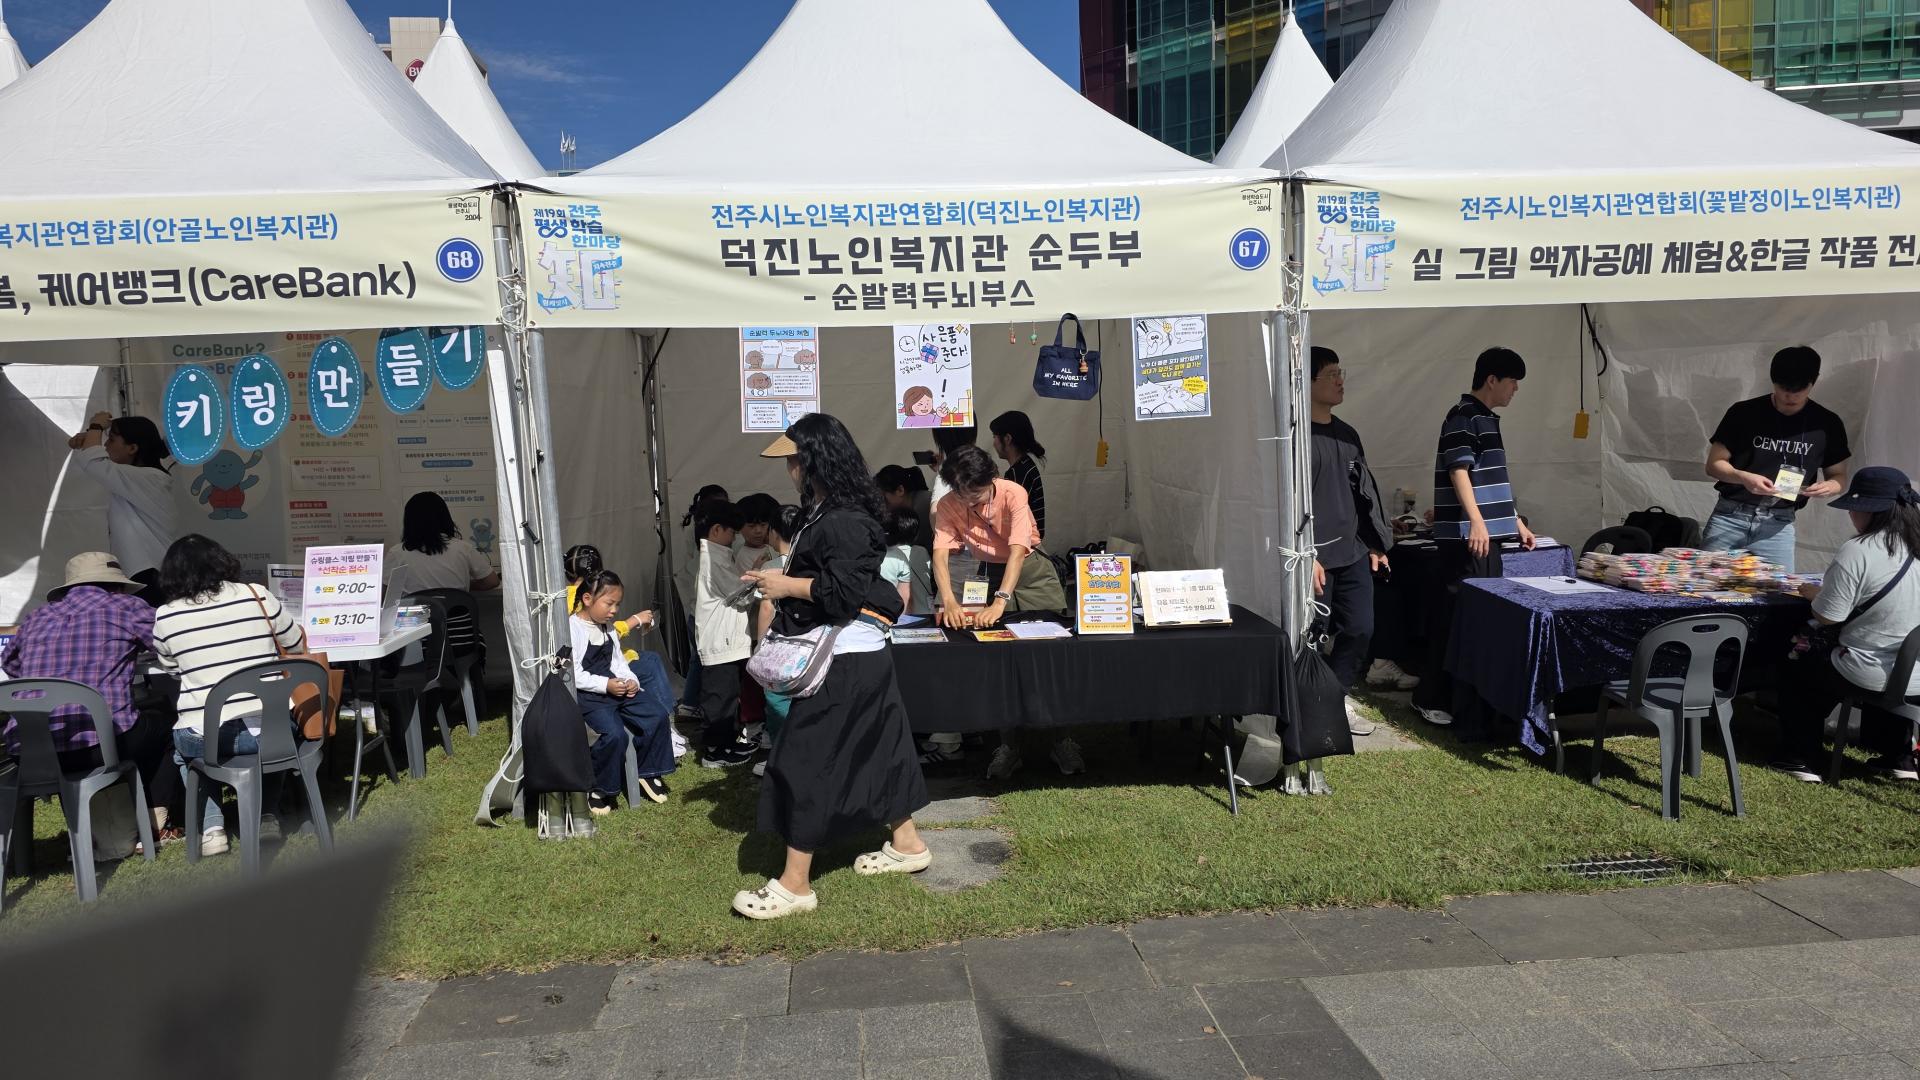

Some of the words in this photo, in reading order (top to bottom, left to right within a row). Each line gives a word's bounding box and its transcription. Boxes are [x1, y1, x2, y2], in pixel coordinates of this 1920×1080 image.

[1317, 195, 1347, 204] 제19회
[1350, 192, 1381, 205] 전주
[1460, 184, 1901, 221] 전주시노인복지관연합회(꽃밭정이노인복지관)
[533, 208, 566, 218] 제19회
[568, 205, 602, 219] 전주
[711, 195, 1141, 229] 전주시노인복지관연합회(덕진노인복지관)
[1349, 205, 1380, 219] 학습
[0, 213, 339, 248] 복지관연합회(안골노인복지관)
[570, 219, 604, 234] 학습
[1350, 220, 1396, 233] 한마당
[572, 234, 622, 249] 한마당
[1239, 241, 1261, 258] 67
[447, 251, 474, 269] 68
[720, 234, 1008, 277] 덕진노인복지관
[1028, 230, 1142, 272] 순두부
[1412, 248, 1443, 281] 실
[1455, 246, 1518, 280] 그림
[1529, 243, 1653, 278] 액자공예
[1661, 237, 1811, 275] 체험&한글
[1820, 235, 1879, 269] 작품
[1888, 234, 1920, 268] 전
[37, 260, 417, 307] 케어뱅크(CareBank)
[831, 280, 1035, 311] 순발력두뇌부스
[922, 325, 958, 344] 사은품
[941, 344, 968, 363] 준다!
[1752, 435, 1814, 456] CENTURY
[337, 582, 376, 595] 9:00~
[334, 613, 375, 626] 13:10~
